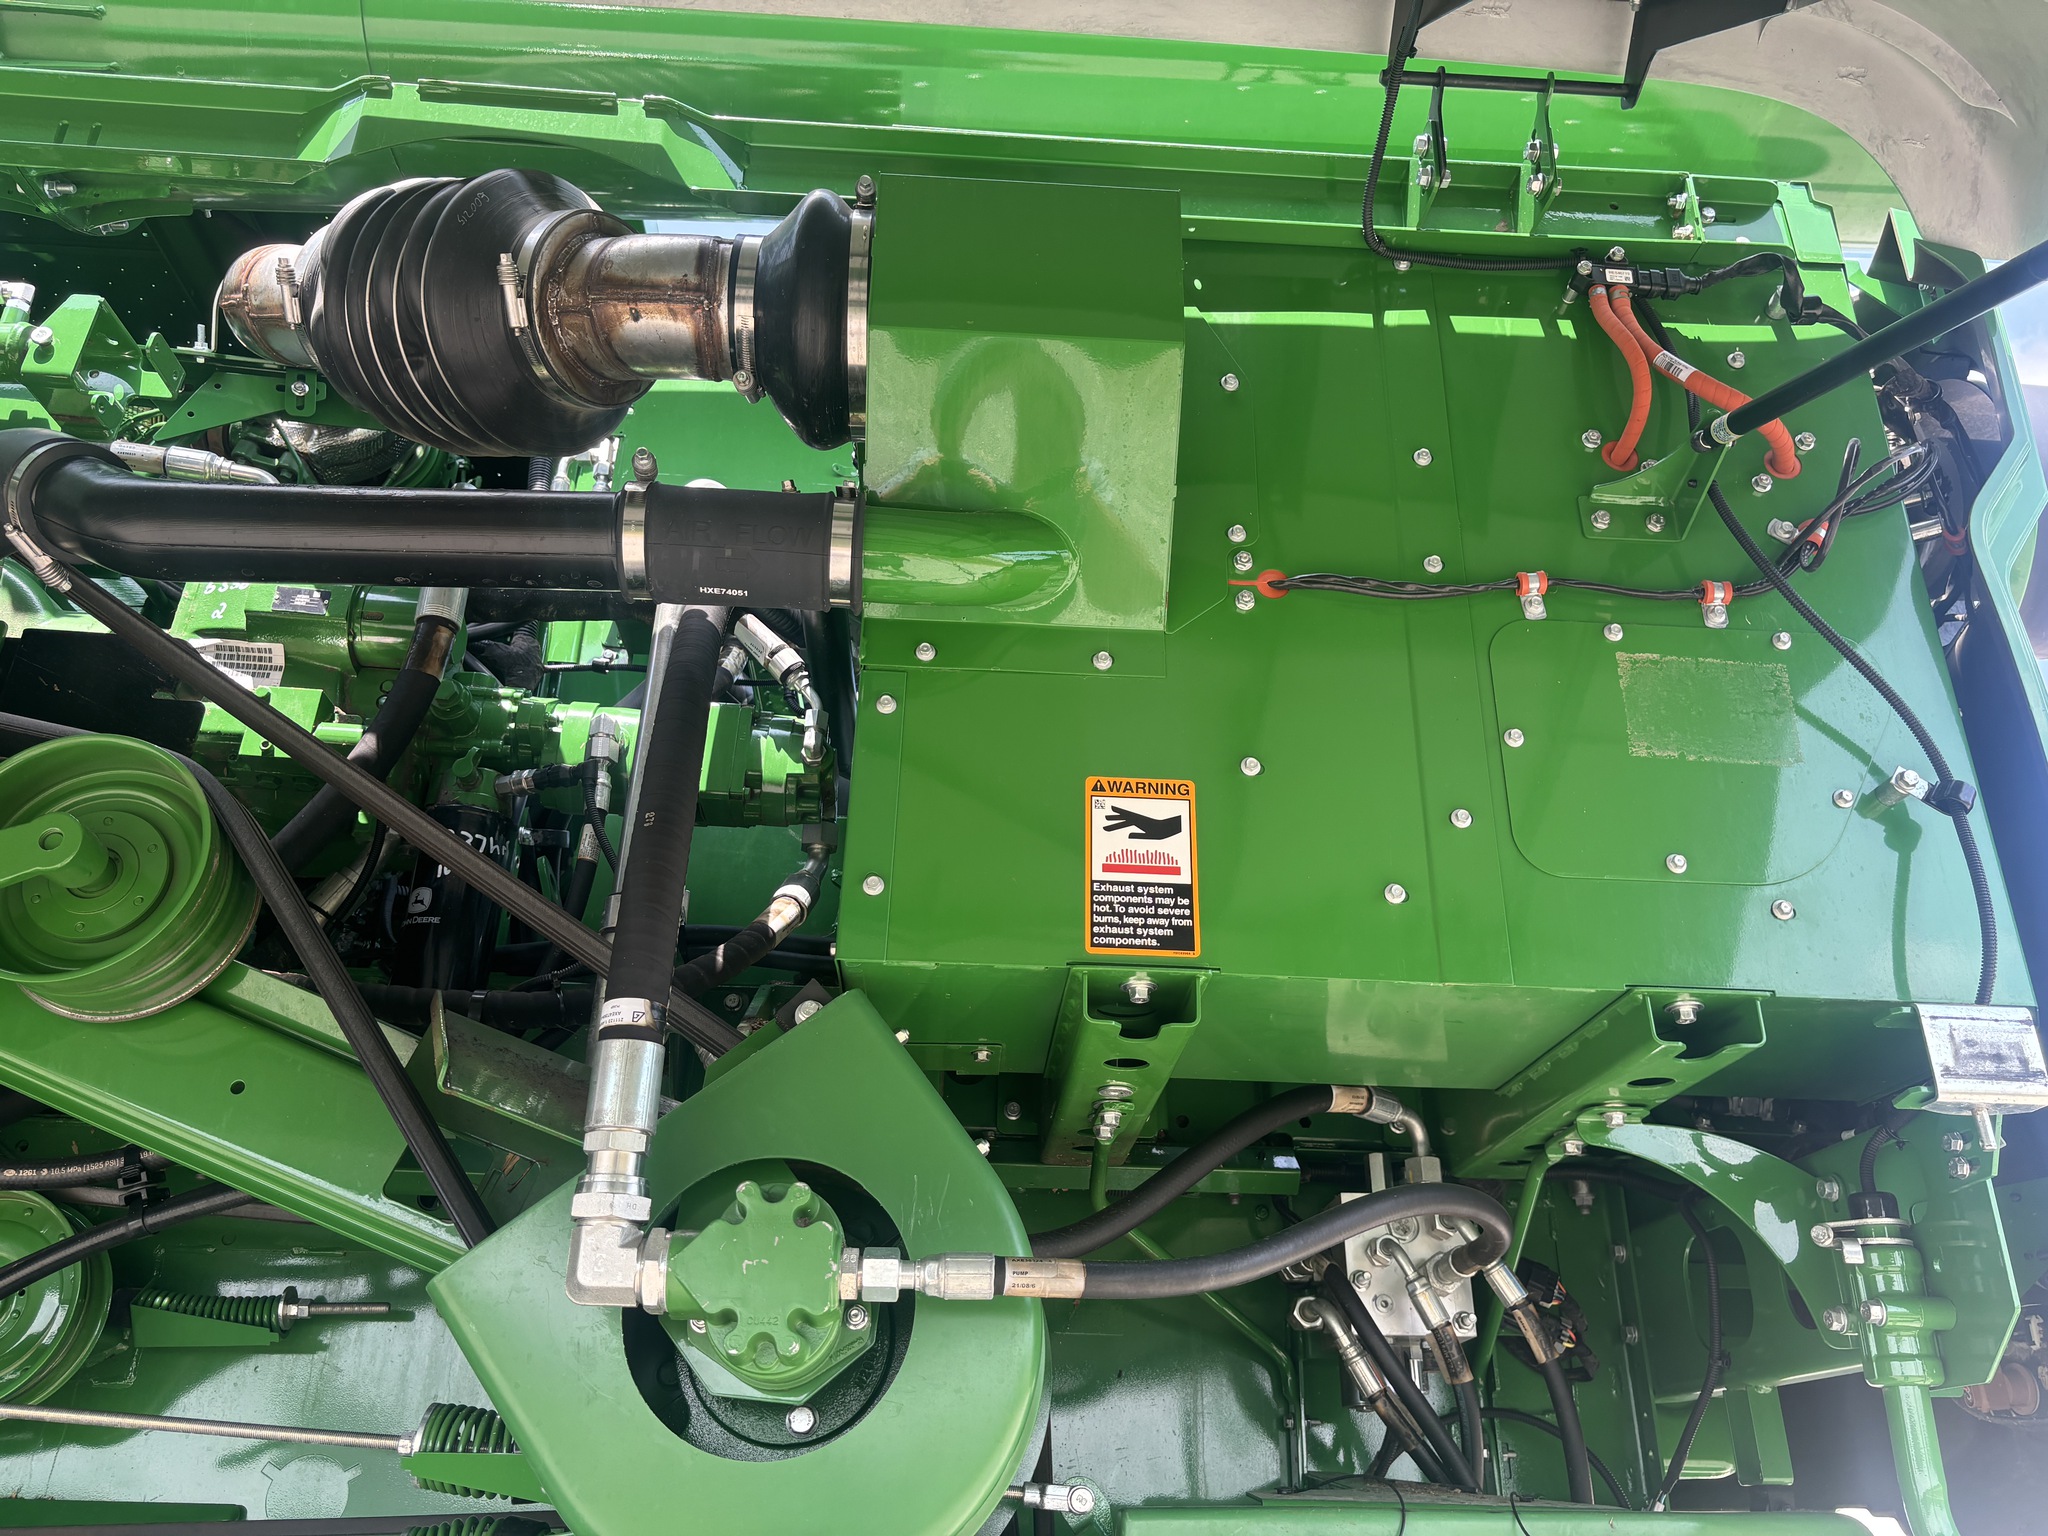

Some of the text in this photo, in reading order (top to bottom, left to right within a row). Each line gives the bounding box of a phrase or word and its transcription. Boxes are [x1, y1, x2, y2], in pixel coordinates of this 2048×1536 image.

[667, 519, 814, 549] AIR FLOW
[699, 586, 749, 597] HXE74051
[1107, 780, 1190, 796] WARNING
[1093, 882, 1174, 896] Exhaust system
[1093, 894, 1190, 906] components may be
[1093, 904, 1191, 916] hot. To avoid severe
[1093, 914, 1192, 927] burns, keep away from
[1093, 925, 1174, 938] exhaust system
[1093, 936, 1160, 947] components.
[67, 1165, 82, 1173] MPa
[83, 1161, 104, 1173] [1525
[104, 1158, 119, 1168] PSI]
